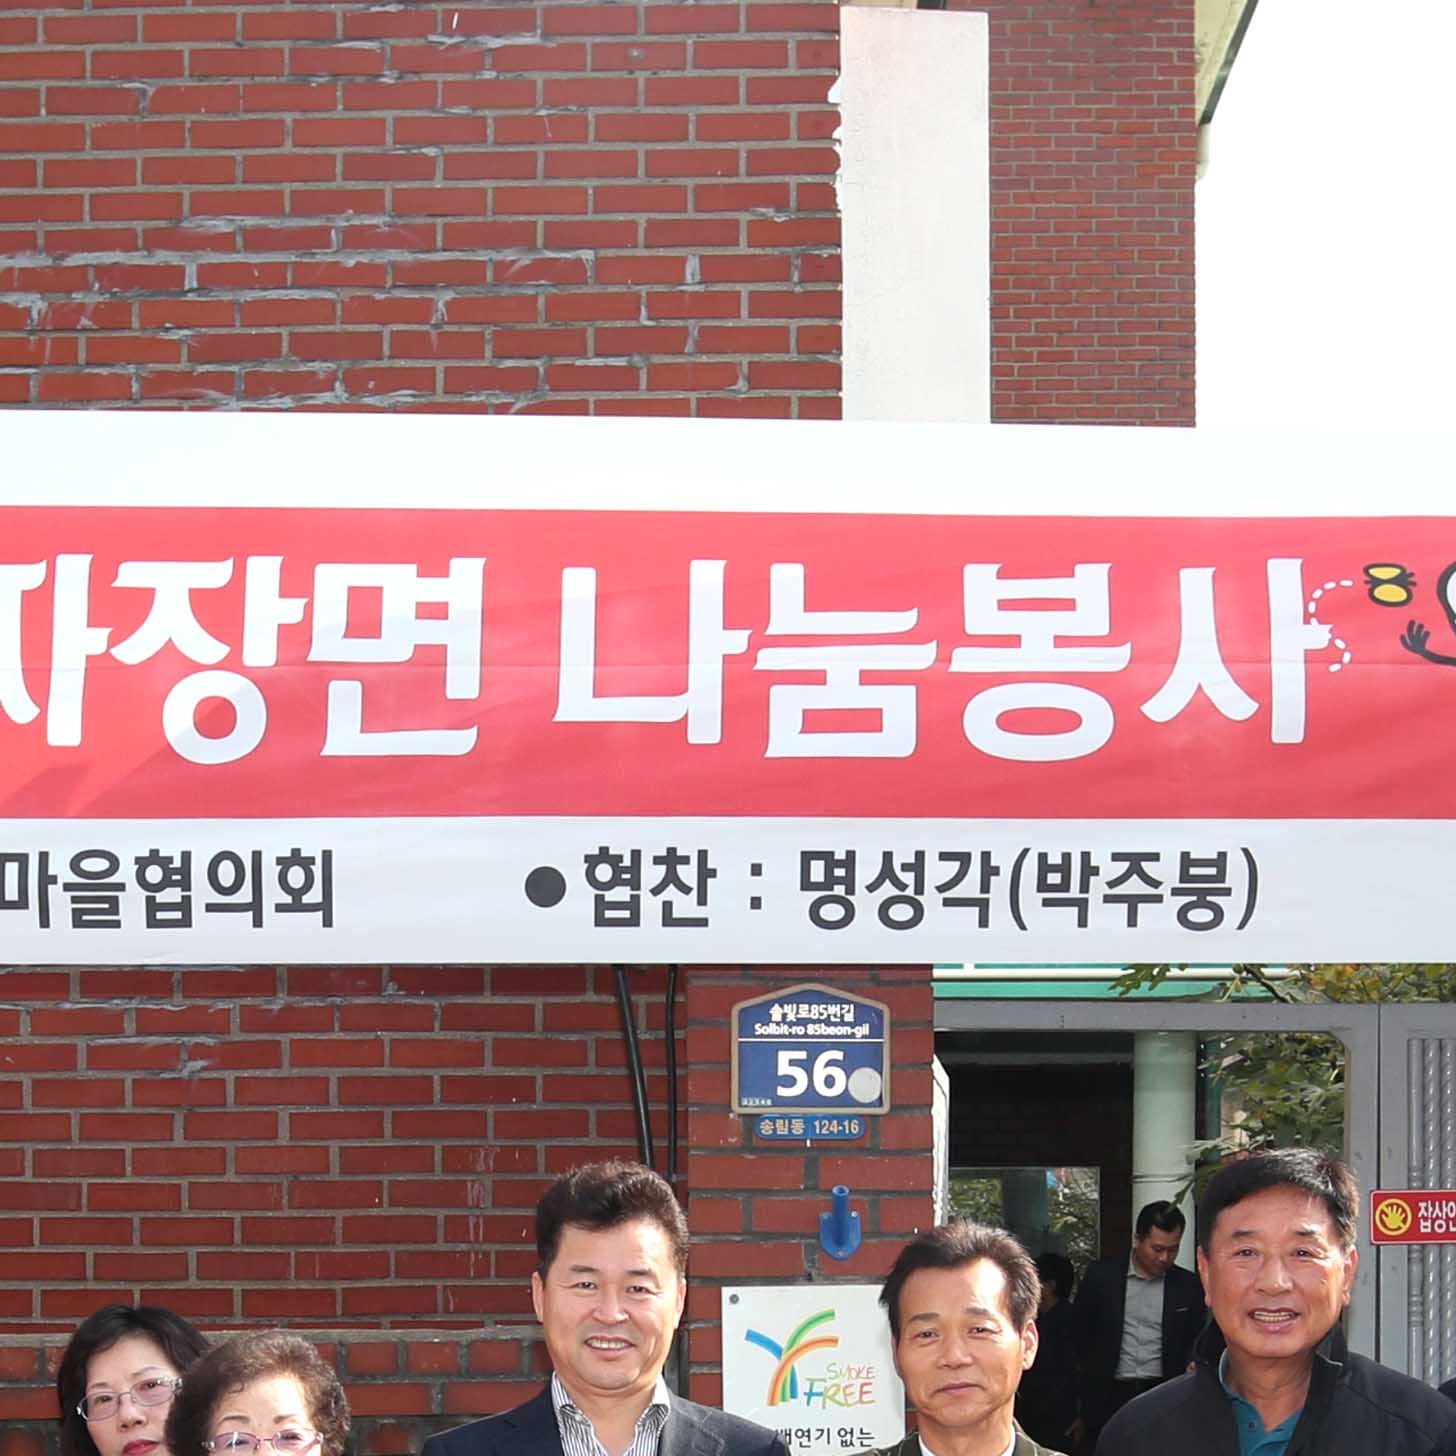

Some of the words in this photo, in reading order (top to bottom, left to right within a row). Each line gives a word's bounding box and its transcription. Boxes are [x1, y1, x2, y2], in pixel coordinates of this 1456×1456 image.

[551, 557, 1334, 763] 나눔봉사
[583, 845, 718, 929] 협찬
[798, 846, 1260, 932] 명성각(박주붕)
[769, 1003, 855, 1022] 솔빛로85번길
[754, 1023, 806, 1036] Solbit-ro
[806, 1023, 870, 1038] 85beon-gil
[776, 1049, 847, 1098] 56
[759, 1118, 806, 1135] 송림동
[813, 1119, 860, 1135] 124-16
[826, 1362, 876, 1382] SMOKE
[803, 1377, 876, 1410] FREE
[836, 1427, 876, 1448] 없는
